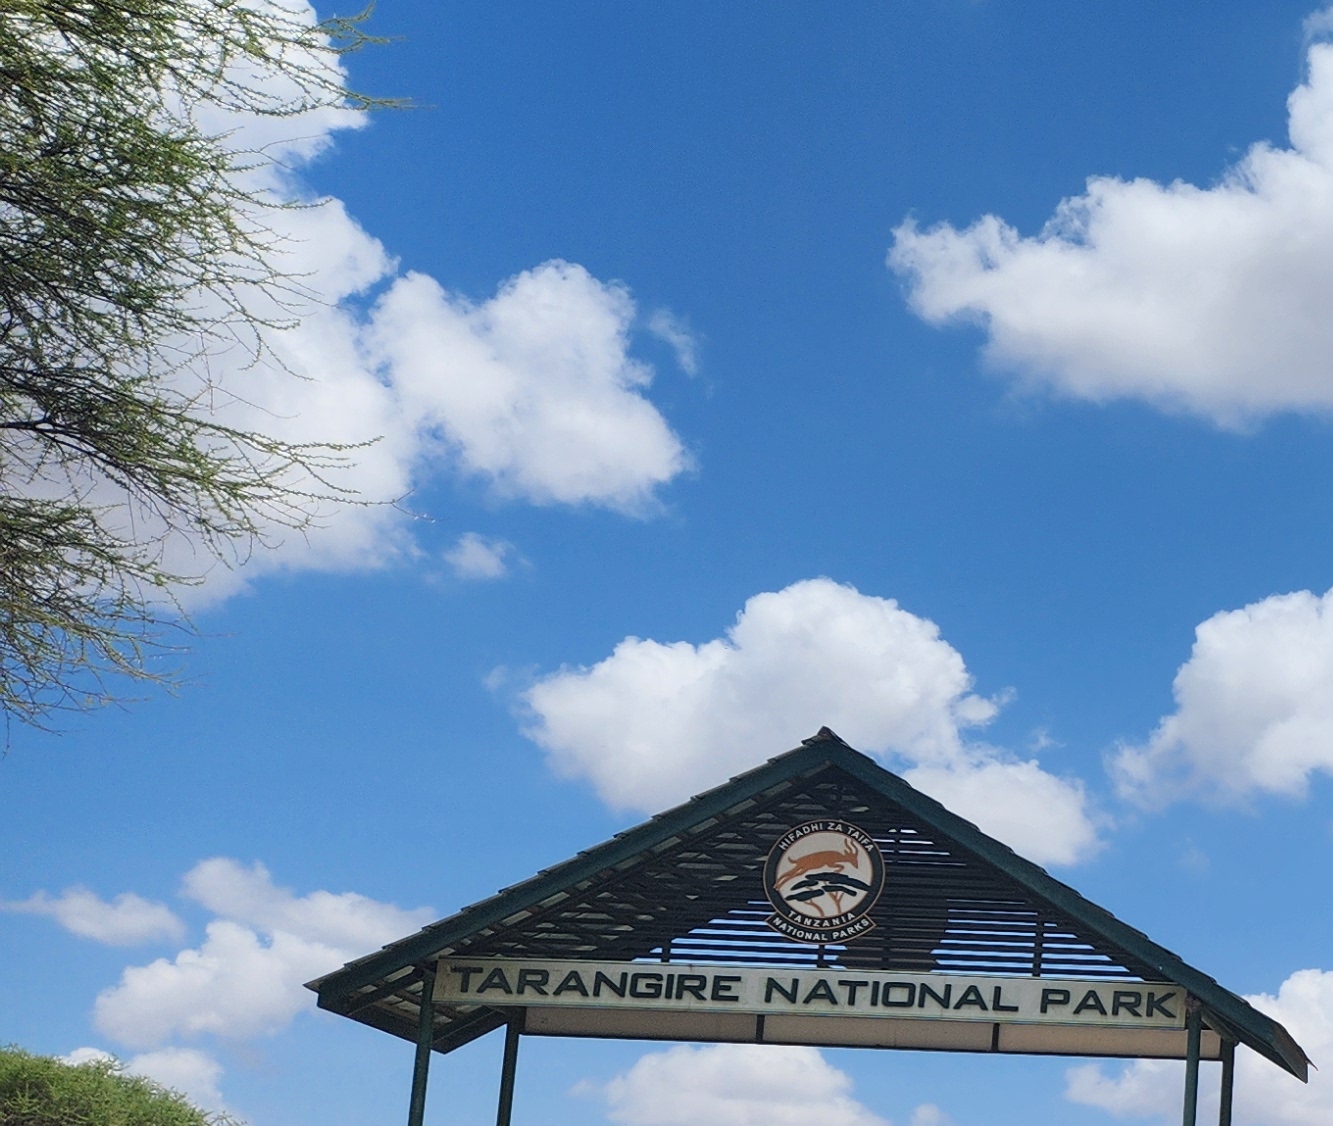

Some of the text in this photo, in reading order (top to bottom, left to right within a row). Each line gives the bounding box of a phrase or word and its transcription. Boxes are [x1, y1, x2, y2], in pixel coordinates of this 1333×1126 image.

[778, 822, 875, 852] HIFADHI ZA TAIFA
[772, 917, 870, 941] NATIONAL PARKS
[788, 910, 856, 928] TANZANIA
[452, 966, 1177, 1018] TARANGIRE NATIONAL PARK
